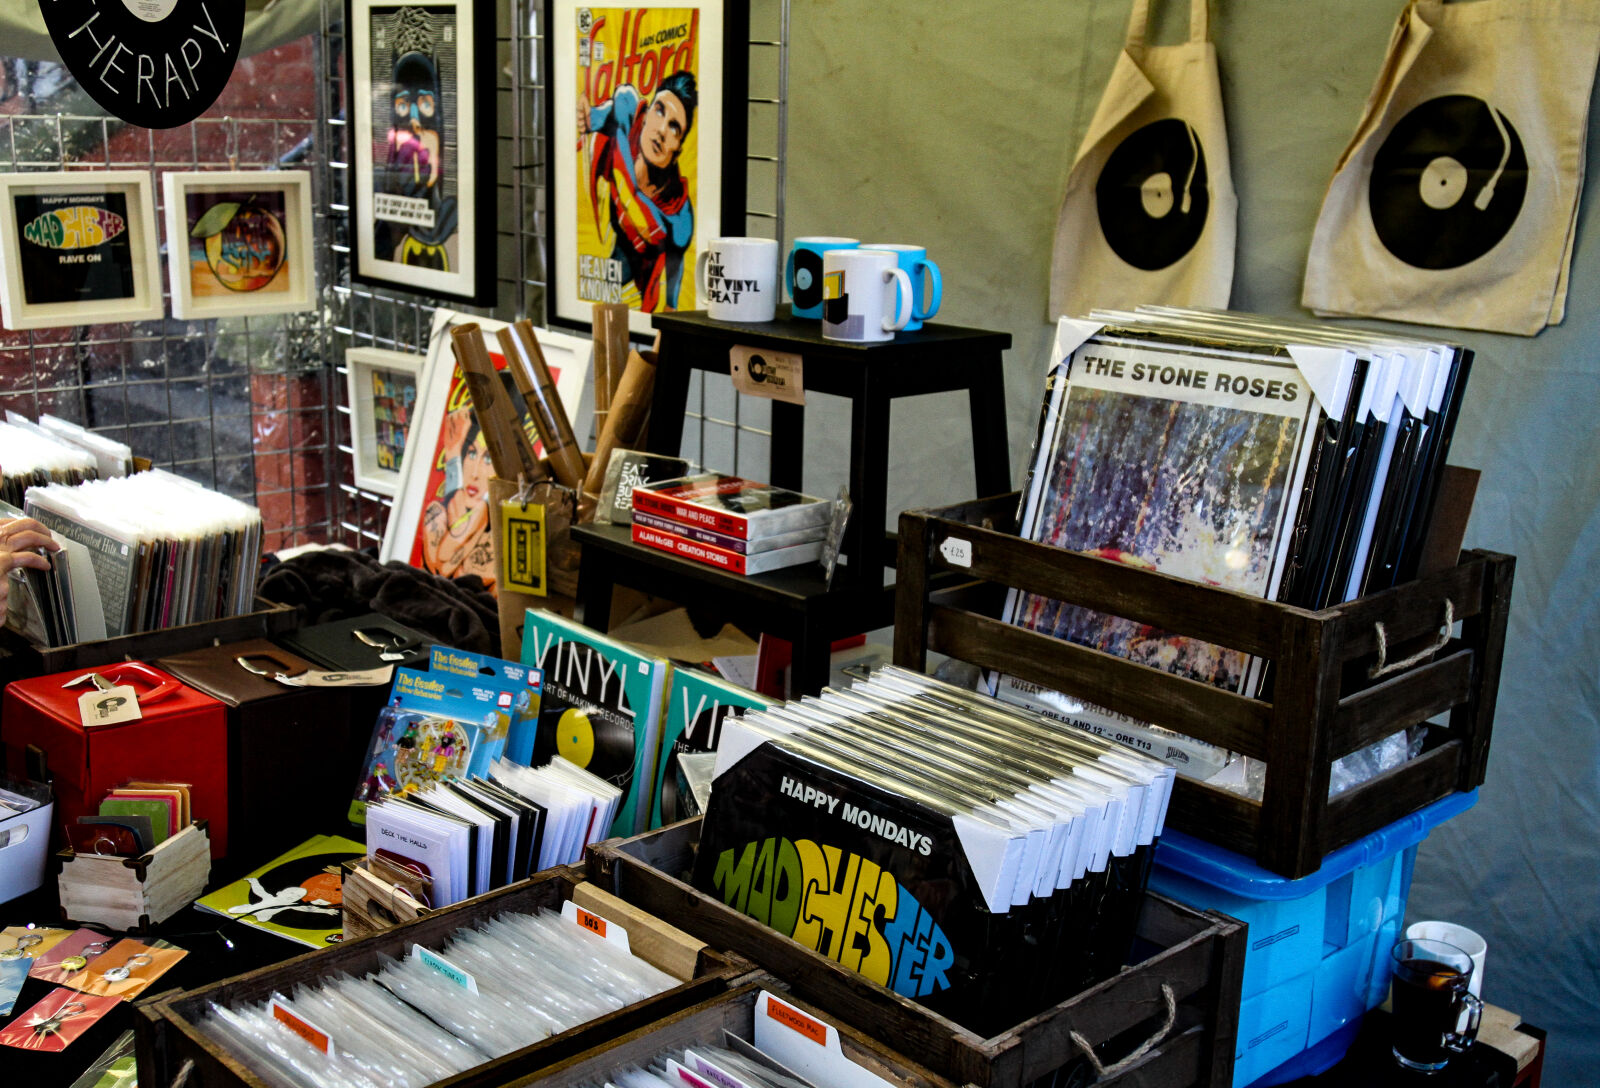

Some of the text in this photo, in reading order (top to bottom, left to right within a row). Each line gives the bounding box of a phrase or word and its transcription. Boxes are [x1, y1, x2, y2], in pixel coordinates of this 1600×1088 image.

[655, 23, 688, 44] COMICS
[68, 2, 230, 109] HERAPY.
[69, 195, 105, 203] MONDAYS
[24, 206, 126, 249] MADCHESTER
[59, 253, 102, 264] RAVE ON
[579, 254, 622, 282] HEAVEN
[723, 278, 761, 292] VINYL
[1084, 356, 1298, 401] THE STONE ROSES
[621, 462, 649, 476] EAT
[676, 506, 688, 516] WAR
[688, 510, 699, 521] AND
[699, 513, 716, 526] PEACE
[102, 538, 117, 554] Hits
[639, 531, 728, 565] ALAN McGEE CREATION STORIES
[533, 625, 637, 718] VINYL
[1011, 678, 1044, 695] WHAT
[557, 689, 567, 699] OF
[568, 693, 598, 713] MAKING
[600, 707, 635, 733] RECORDS
[1073, 719, 1092, 732] AND
[1115, 732, 1135, 745] ORE
[1136, 738, 1152, 751] T13
[780, 775, 934, 857] HAPPY MONDAYS
[380, 828, 428, 849] DECK THE HALLS
[713, 836, 956, 999] MADCHESTER
